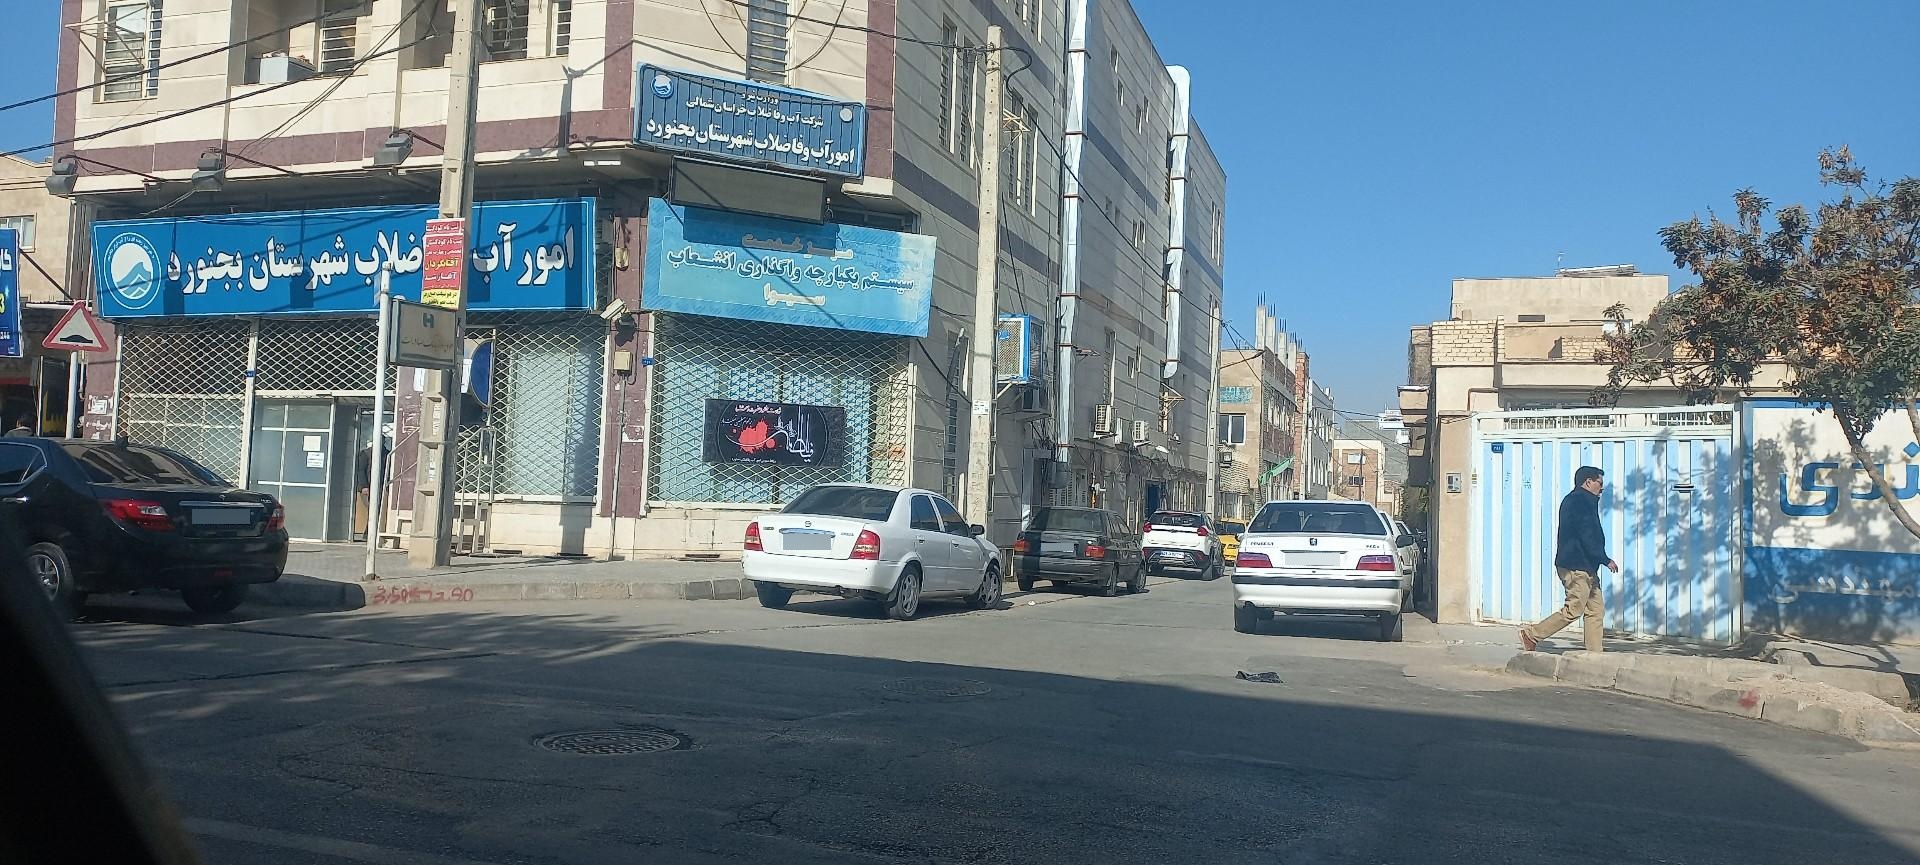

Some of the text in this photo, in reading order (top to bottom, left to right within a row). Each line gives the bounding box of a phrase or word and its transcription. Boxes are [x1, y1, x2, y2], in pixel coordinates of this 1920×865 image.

[686, 96, 715, 111] شمالی
[714, 101, 748, 118] خراسان
[646, 117, 695, 144] بجنورد
[786, 111, 800, 124] آب
[801, 113, 824, 129] شرکت
[695, 123, 754, 150] شهرستان
[810, 139, 834, 159] آب
[826, 148, 855, 168] امور
[472, 222, 518, 285] آب
[515, 224, 575, 286] امور
[742, 232, 803, 253] خدمت
[167, 246, 244, 294] بجنورد
[248, 233, 350, 291] شهرستان
[354, 230, 424, 287] ضلاب
[667, 246, 914, 294] سیستم یکپارچه واگذاری انشعاب
